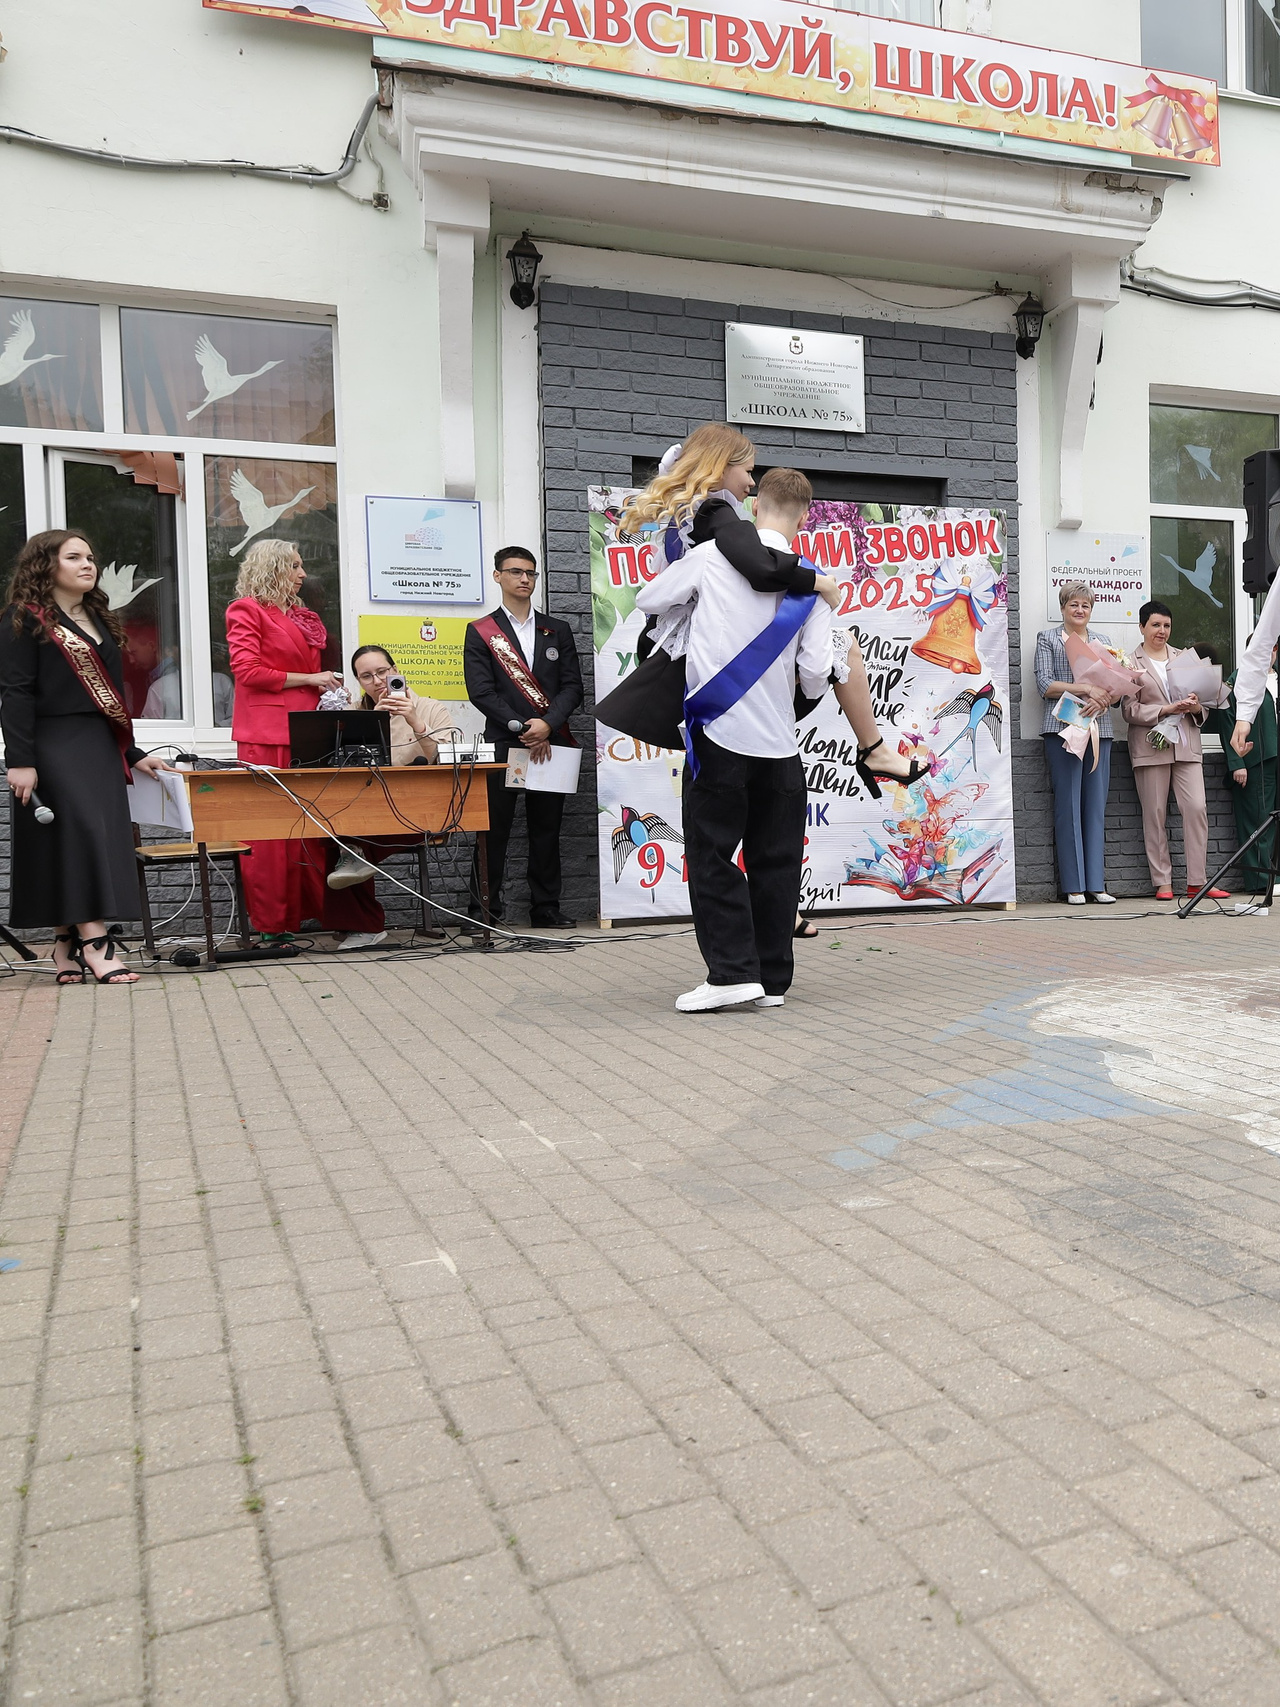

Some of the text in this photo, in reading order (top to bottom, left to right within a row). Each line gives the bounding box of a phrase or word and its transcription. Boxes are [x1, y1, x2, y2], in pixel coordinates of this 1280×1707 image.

[406, 0, 1117, 127] ДРАВСТВУЙ, ШКОЛА!
[740, 373, 852, 389] МУНИЦИПАЛЬНОЕ БЮДЖЕТНОЕ
[753, 382, 840, 396] ОБЩЕОБРАЗОВАТЕЛЬНОЕ
[773, 391, 821, 400] УЧРЕЖДЕНИЕ
[740, 403, 853, 422] «ШКОЛА № 75»
[865, 519, 1001, 565] ЗВОНОК
[1050, 566, 1143, 577] ФЕДЕРАЛЬНЫЙ ПРОЕКТ
[392, 579, 462, 589] «Школа № 75»
[1089, 579, 1143, 591] КАЖДОГО
[836, 573, 937, 616] 2025
[1094, 594, 1122, 603] ЕНКА
[396, 658, 436, 666] «ШКОЛА
[448, 658, 462, 666] 75»
[638, 842, 666, 889] 9
